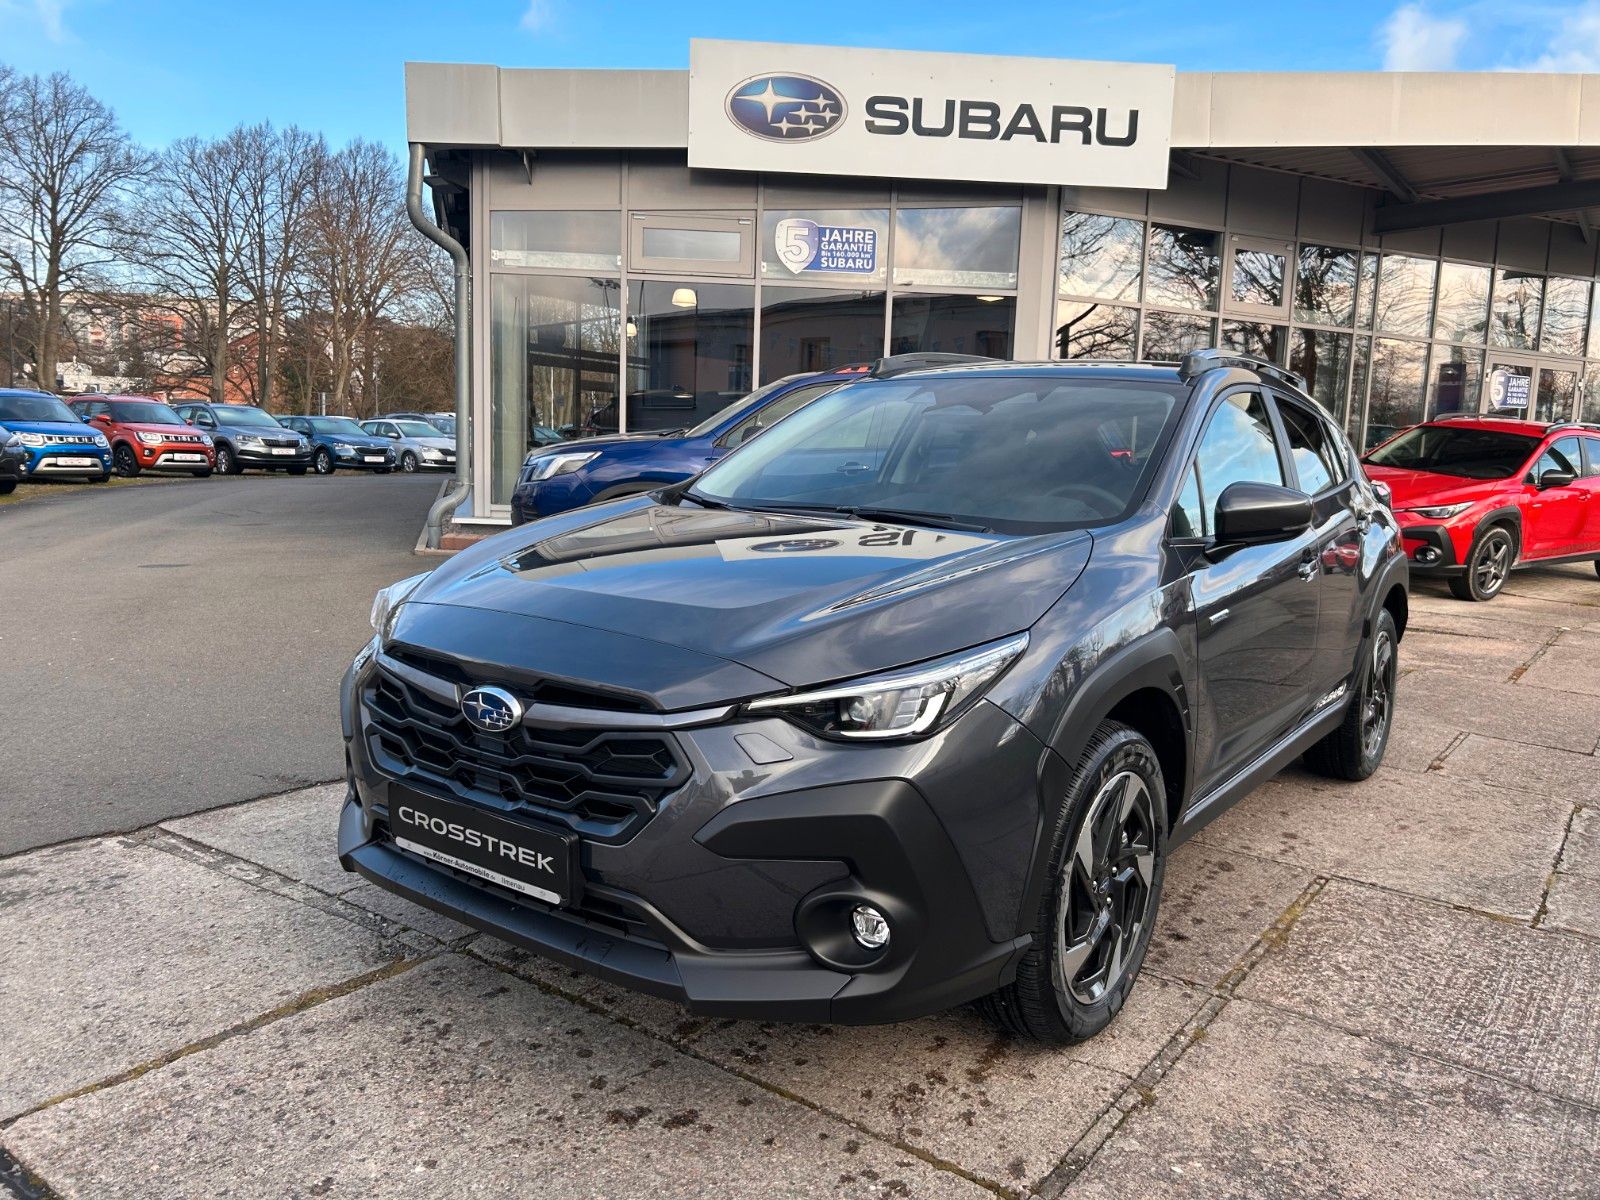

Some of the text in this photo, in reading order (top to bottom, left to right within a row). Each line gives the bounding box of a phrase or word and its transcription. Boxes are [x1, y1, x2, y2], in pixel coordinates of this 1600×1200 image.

[864, 95, 1139, 148] SUBARU
[821, 228, 874, 244] JAHRE
[783, 225, 810, 263] 5
[820, 241, 873, 252] GARANTIE
[820, 256, 873, 269] SUBARU
[1493, 376, 1504, 401] 5
[1508, 377, 1530, 387] JAHRE
[1506, 396, 1527, 405] SUBARU
[398, 806, 555, 874] CROSSTREK
[501, 876, 526, 891] Ilmenau
